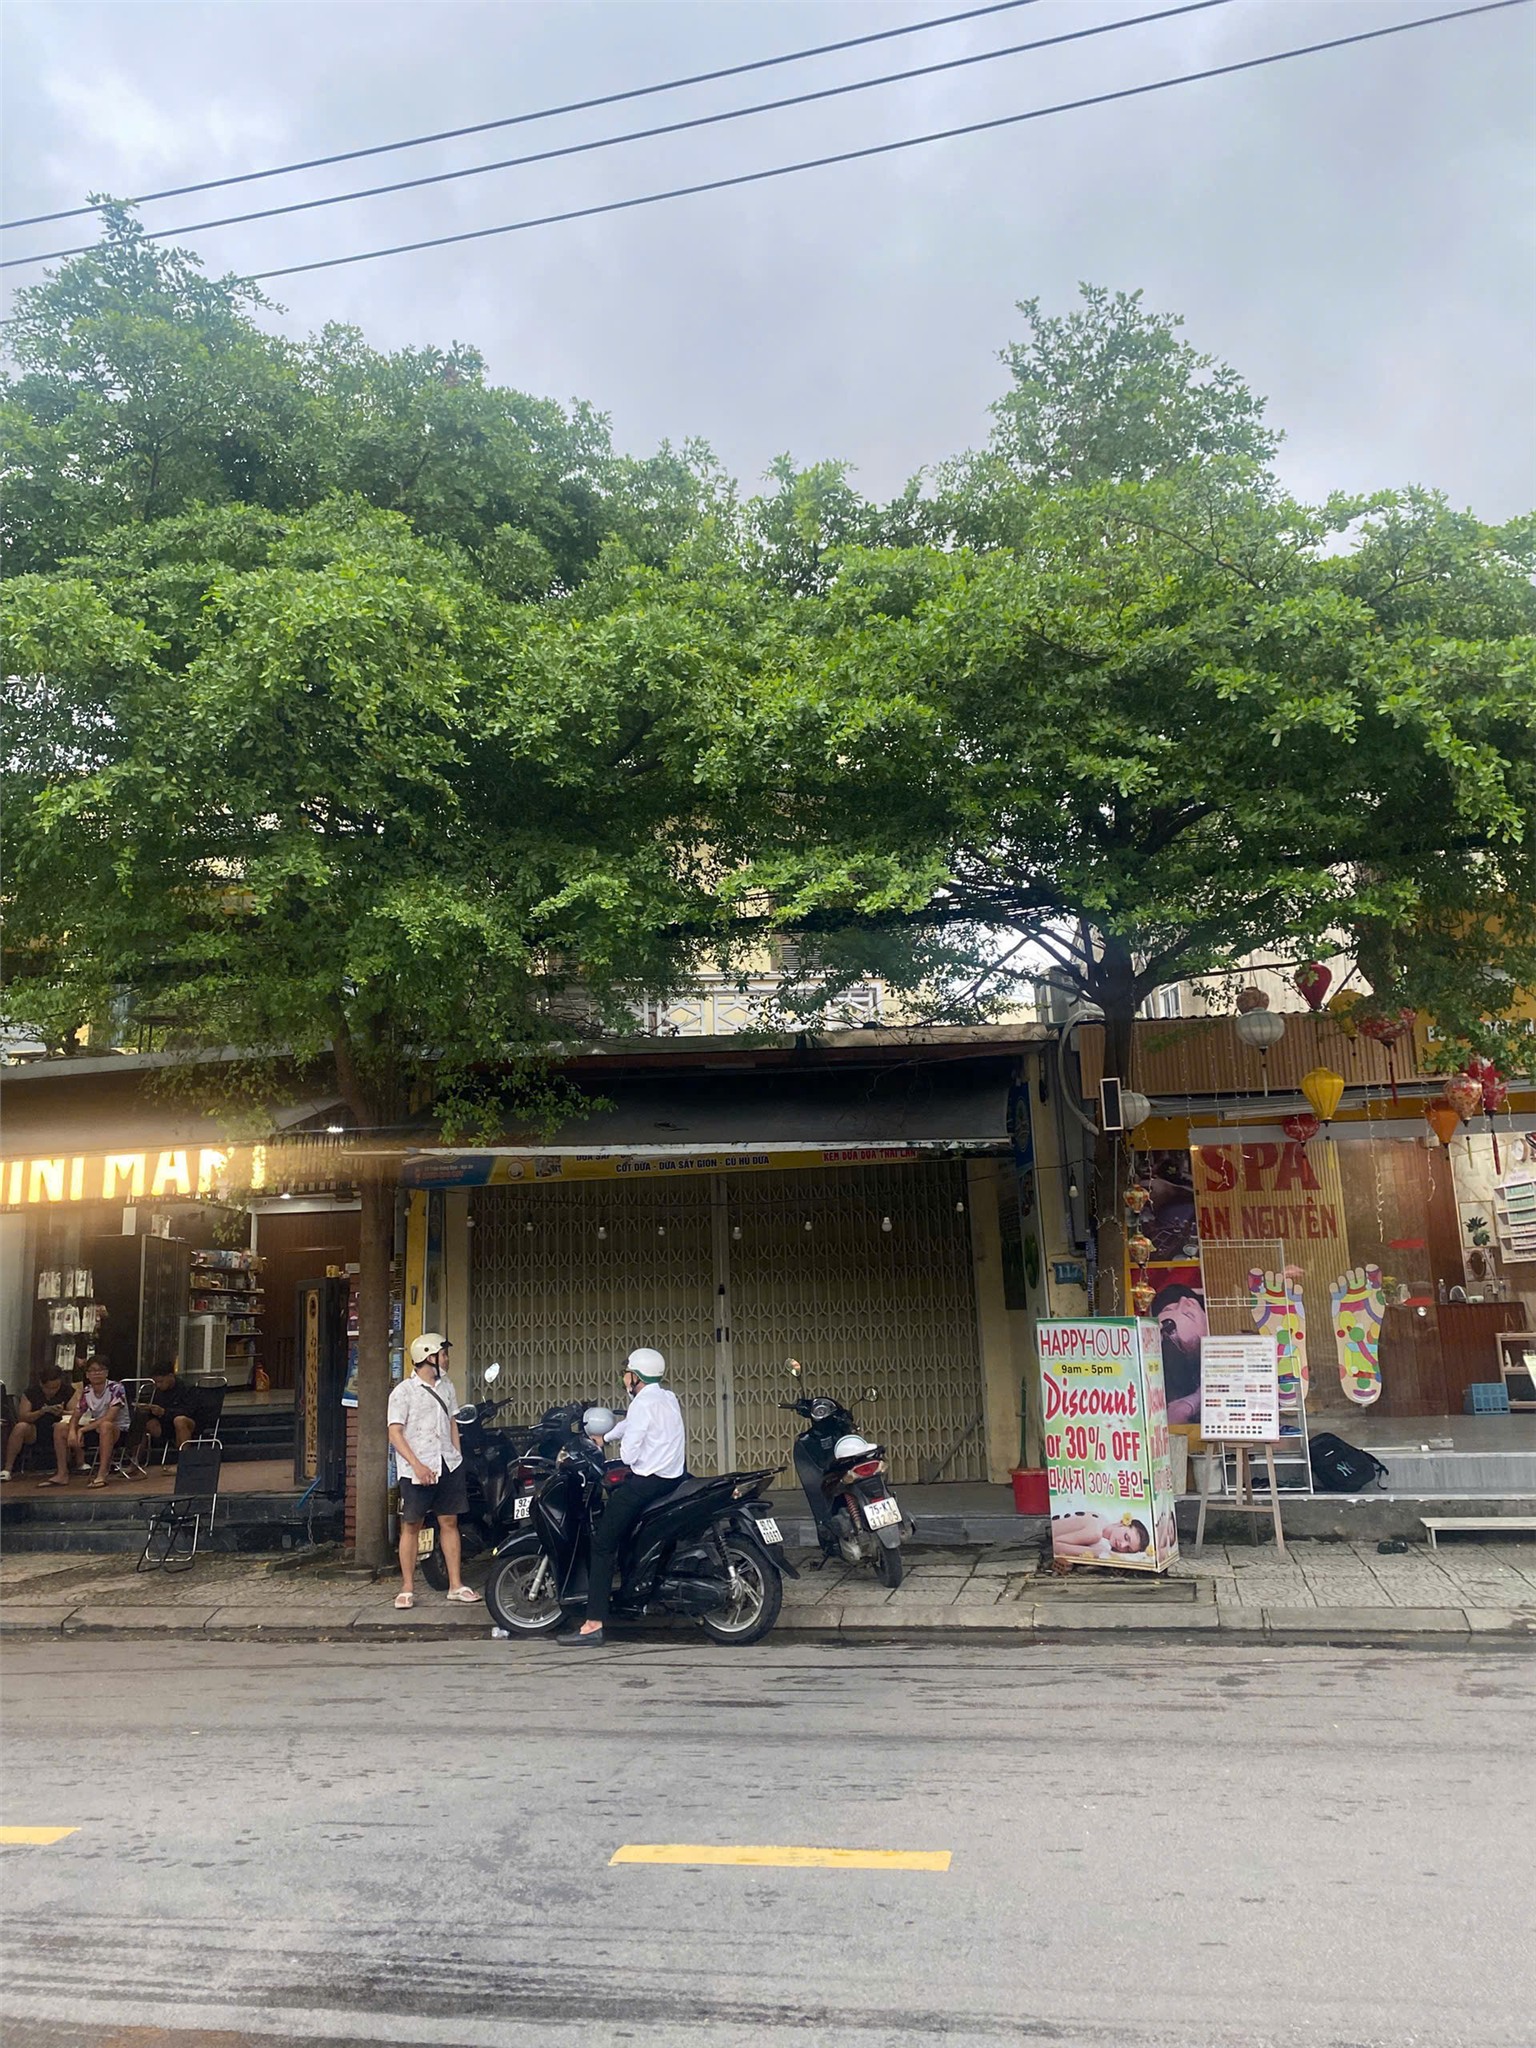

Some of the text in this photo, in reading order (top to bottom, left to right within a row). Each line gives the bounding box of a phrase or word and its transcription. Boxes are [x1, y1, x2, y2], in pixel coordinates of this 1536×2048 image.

[0, 1157, 85, 1205] INI
[1201, 1142, 1321, 1192] SPA
[1058, 1265, 1078, 1278] 117
[1061, 1364, 1082, 1374] 9am
[1091, 1364, 1113, 1375] 5pm
[1043, 1372, 1137, 1420] Discount
[1046, 1434, 1061, 1458] or
[1065, 1426, 1106, 1460] 30%
[1112, 1431, 1140, 1461] OFF
[1049, 1467, 1086, 1495] 마사지
[1088, 1472, 1114, 1495] 30%
[1118, 1470, 1144, 1498] 할인
